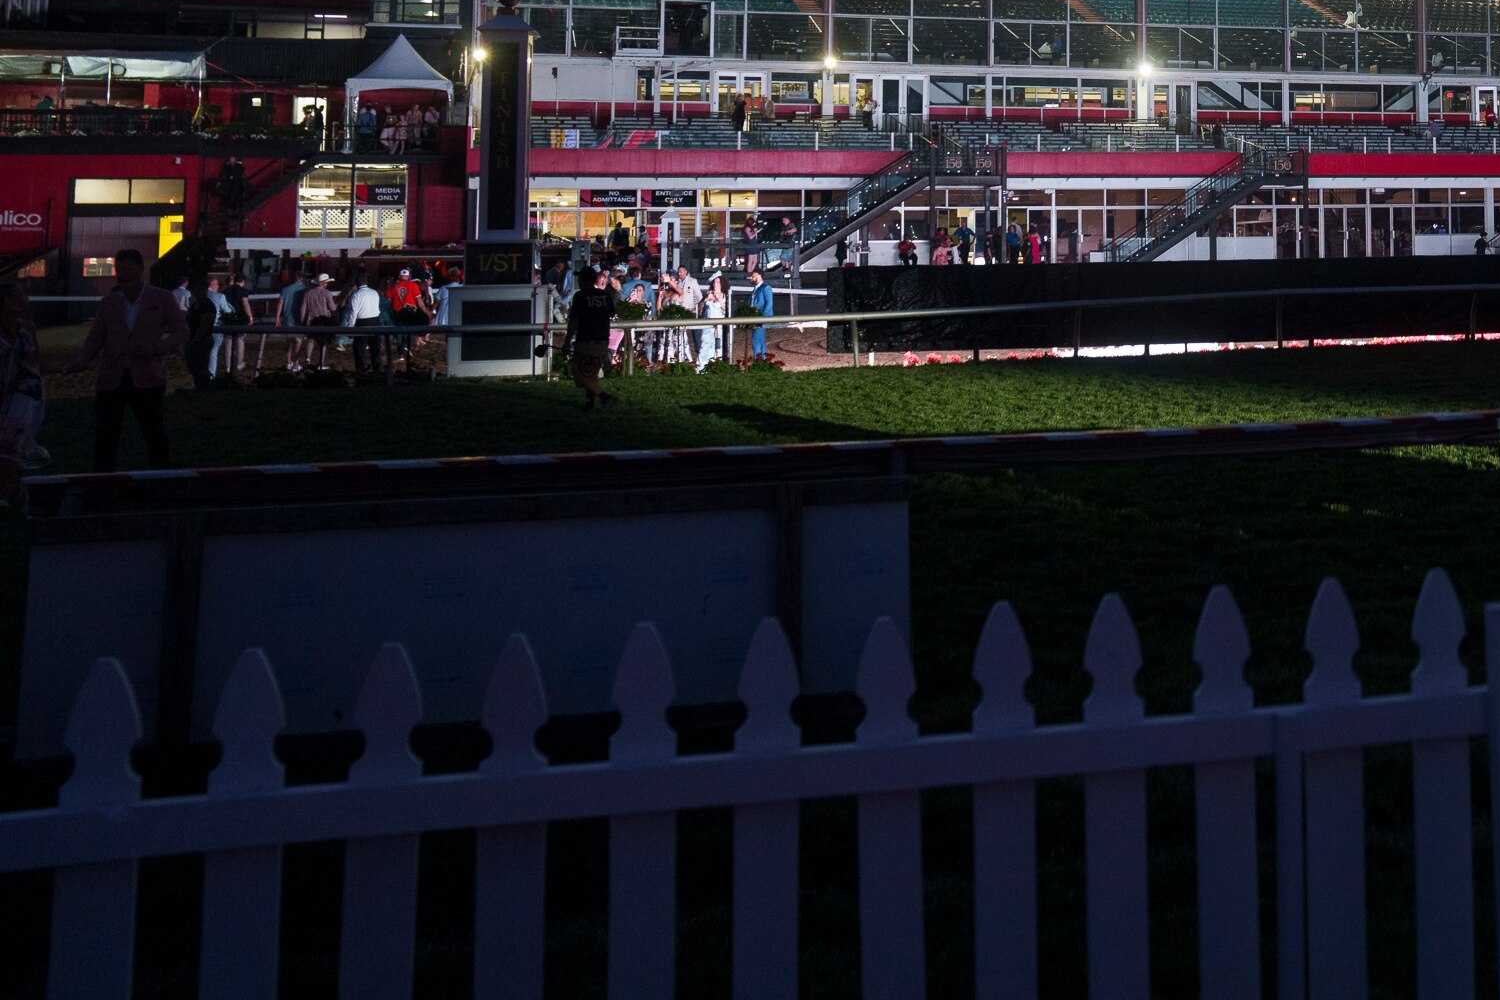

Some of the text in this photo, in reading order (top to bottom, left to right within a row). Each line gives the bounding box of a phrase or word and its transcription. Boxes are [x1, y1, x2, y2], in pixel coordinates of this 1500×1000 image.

[494, 72, 512, 169] FINISH
[945, 158, 962, 169] 150
[975, 158, 992, 169] 150
[1273, 159, 1292, 170] 150
[0, 210, 42, 225] lico
[476, 252, 523, 272] 1/ST
